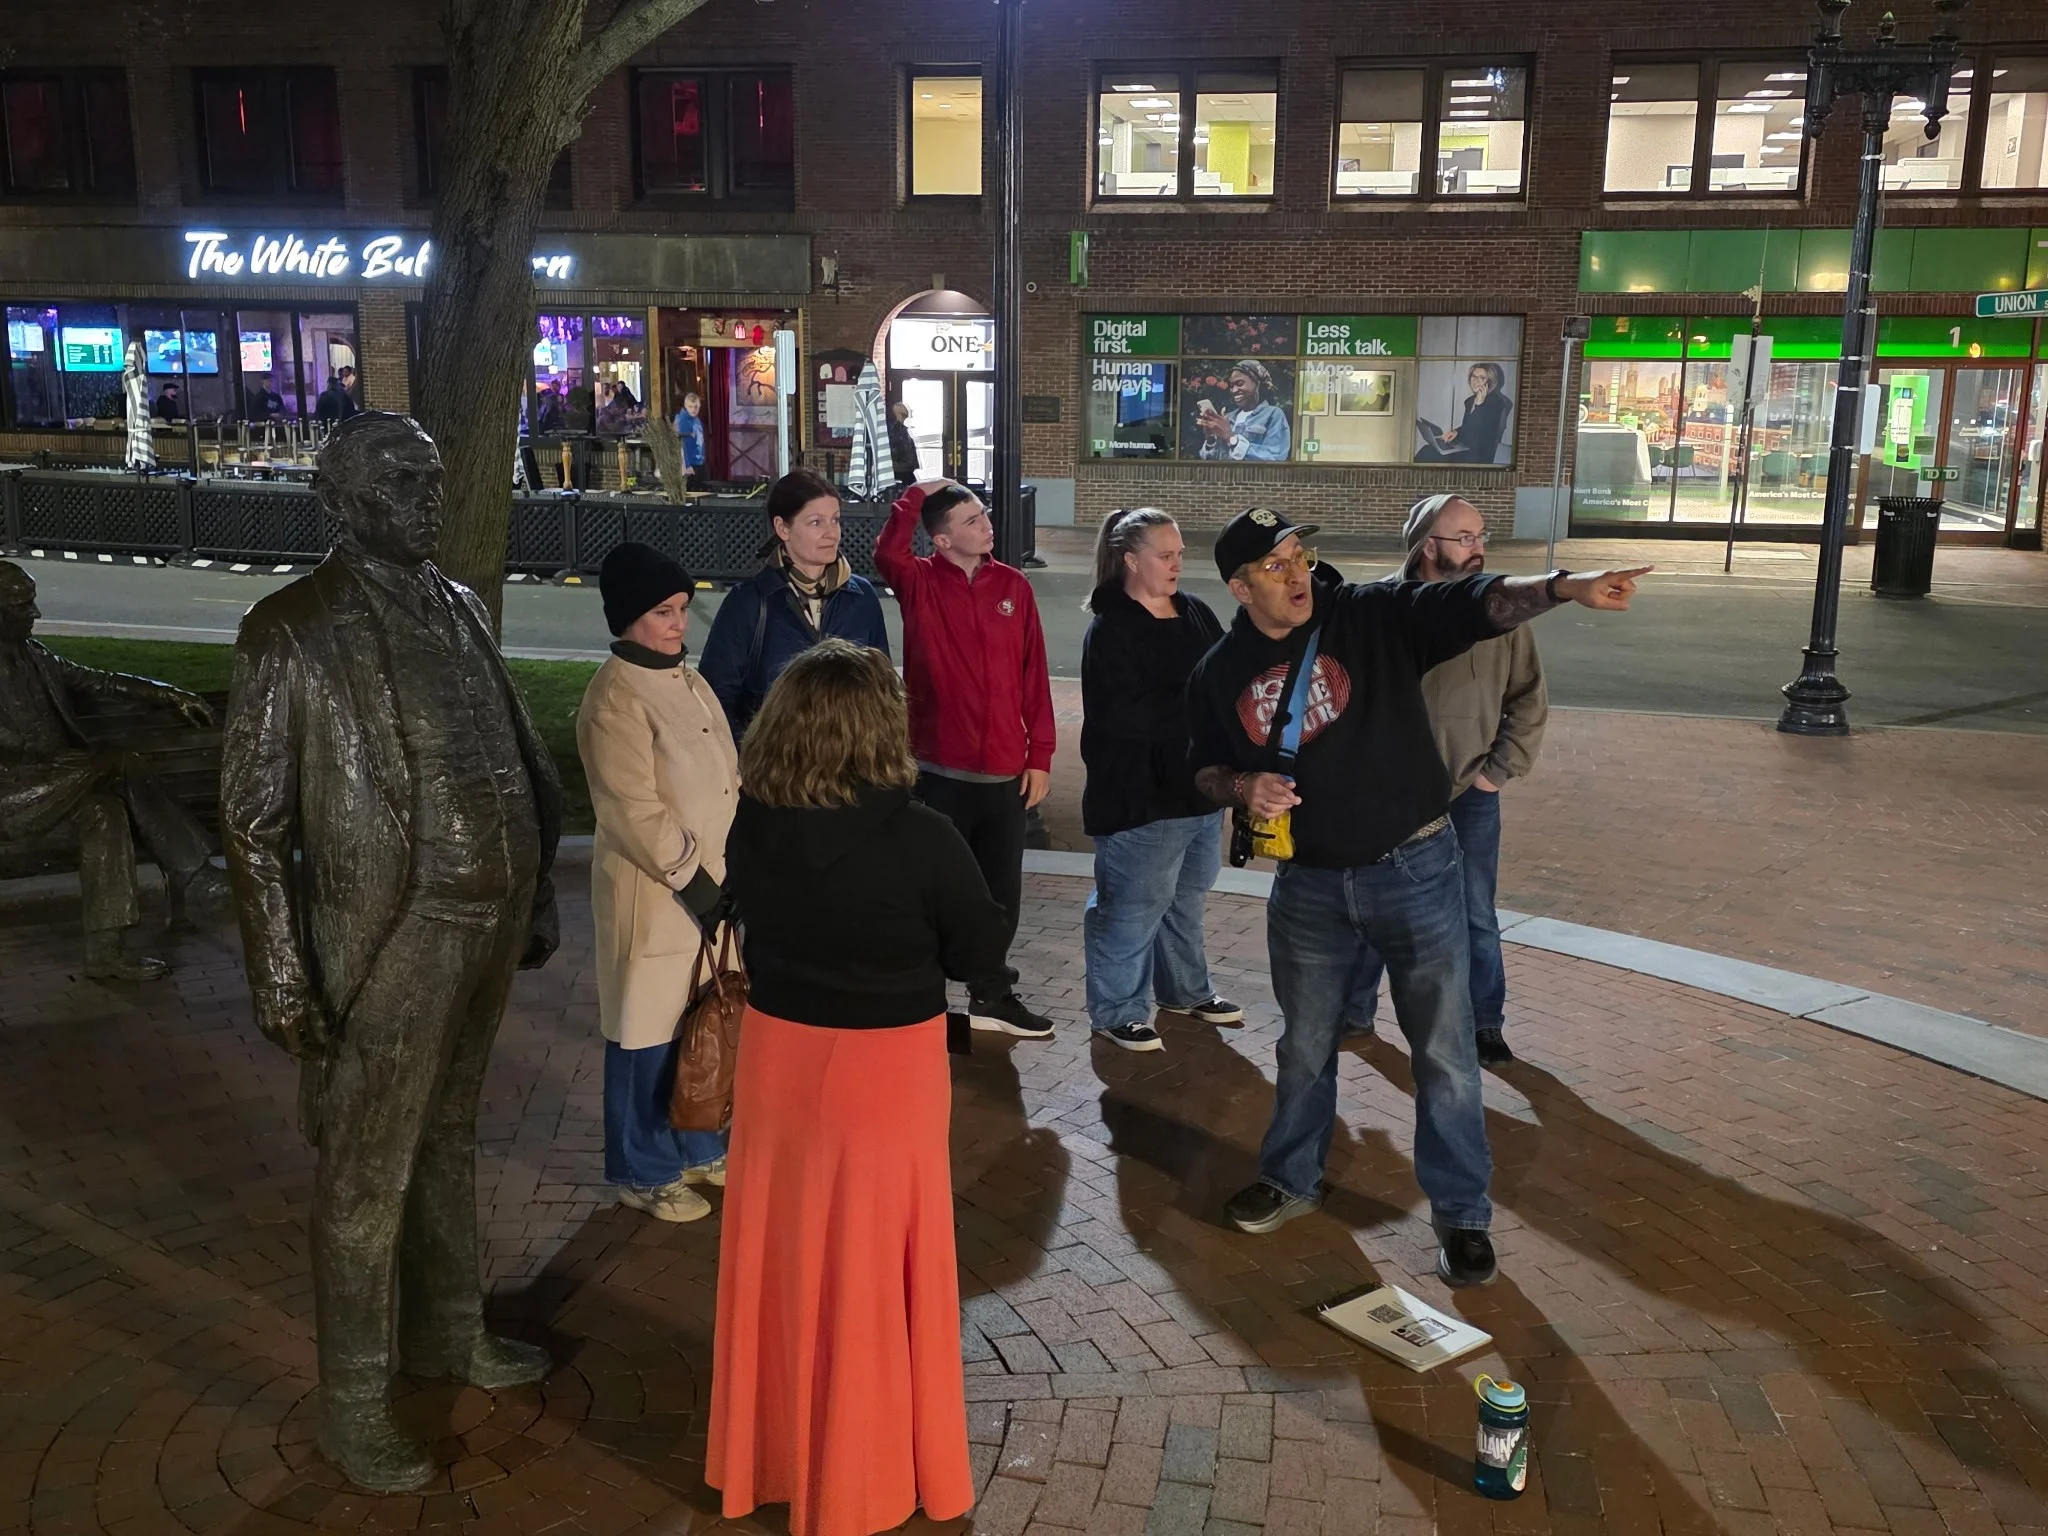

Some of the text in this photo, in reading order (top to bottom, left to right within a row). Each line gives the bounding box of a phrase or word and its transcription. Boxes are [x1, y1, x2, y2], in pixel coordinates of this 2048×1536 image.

[185, 232, 430, 279] The White Bul
[1995, 294, 2037, 313] UNION
[1093, 319, 1147, 339] Digital
[1307, 321, 1350, 338] Less
[1950, 326, 1961, 348] 1
[931, 335, 980, 353] ONE
[1093, 336, 1132, 353] first.
[1306, 338, 1392, 356] bank talk.
[1092, 358, 1153, 376] Human
[1306, 361, 1354, 377] More
[1093, 440, 1157, 450] TD More human.
[1306, 442, 1319, 451] TD
[1925, 469, 1958, 480] TD TD
[1593, 487, 1612, 495] Bank
[1748, 490, 1789, 498] America's
[1790, 491, 1810, 499] Most
[1582, 498, 1621, 506] America's
